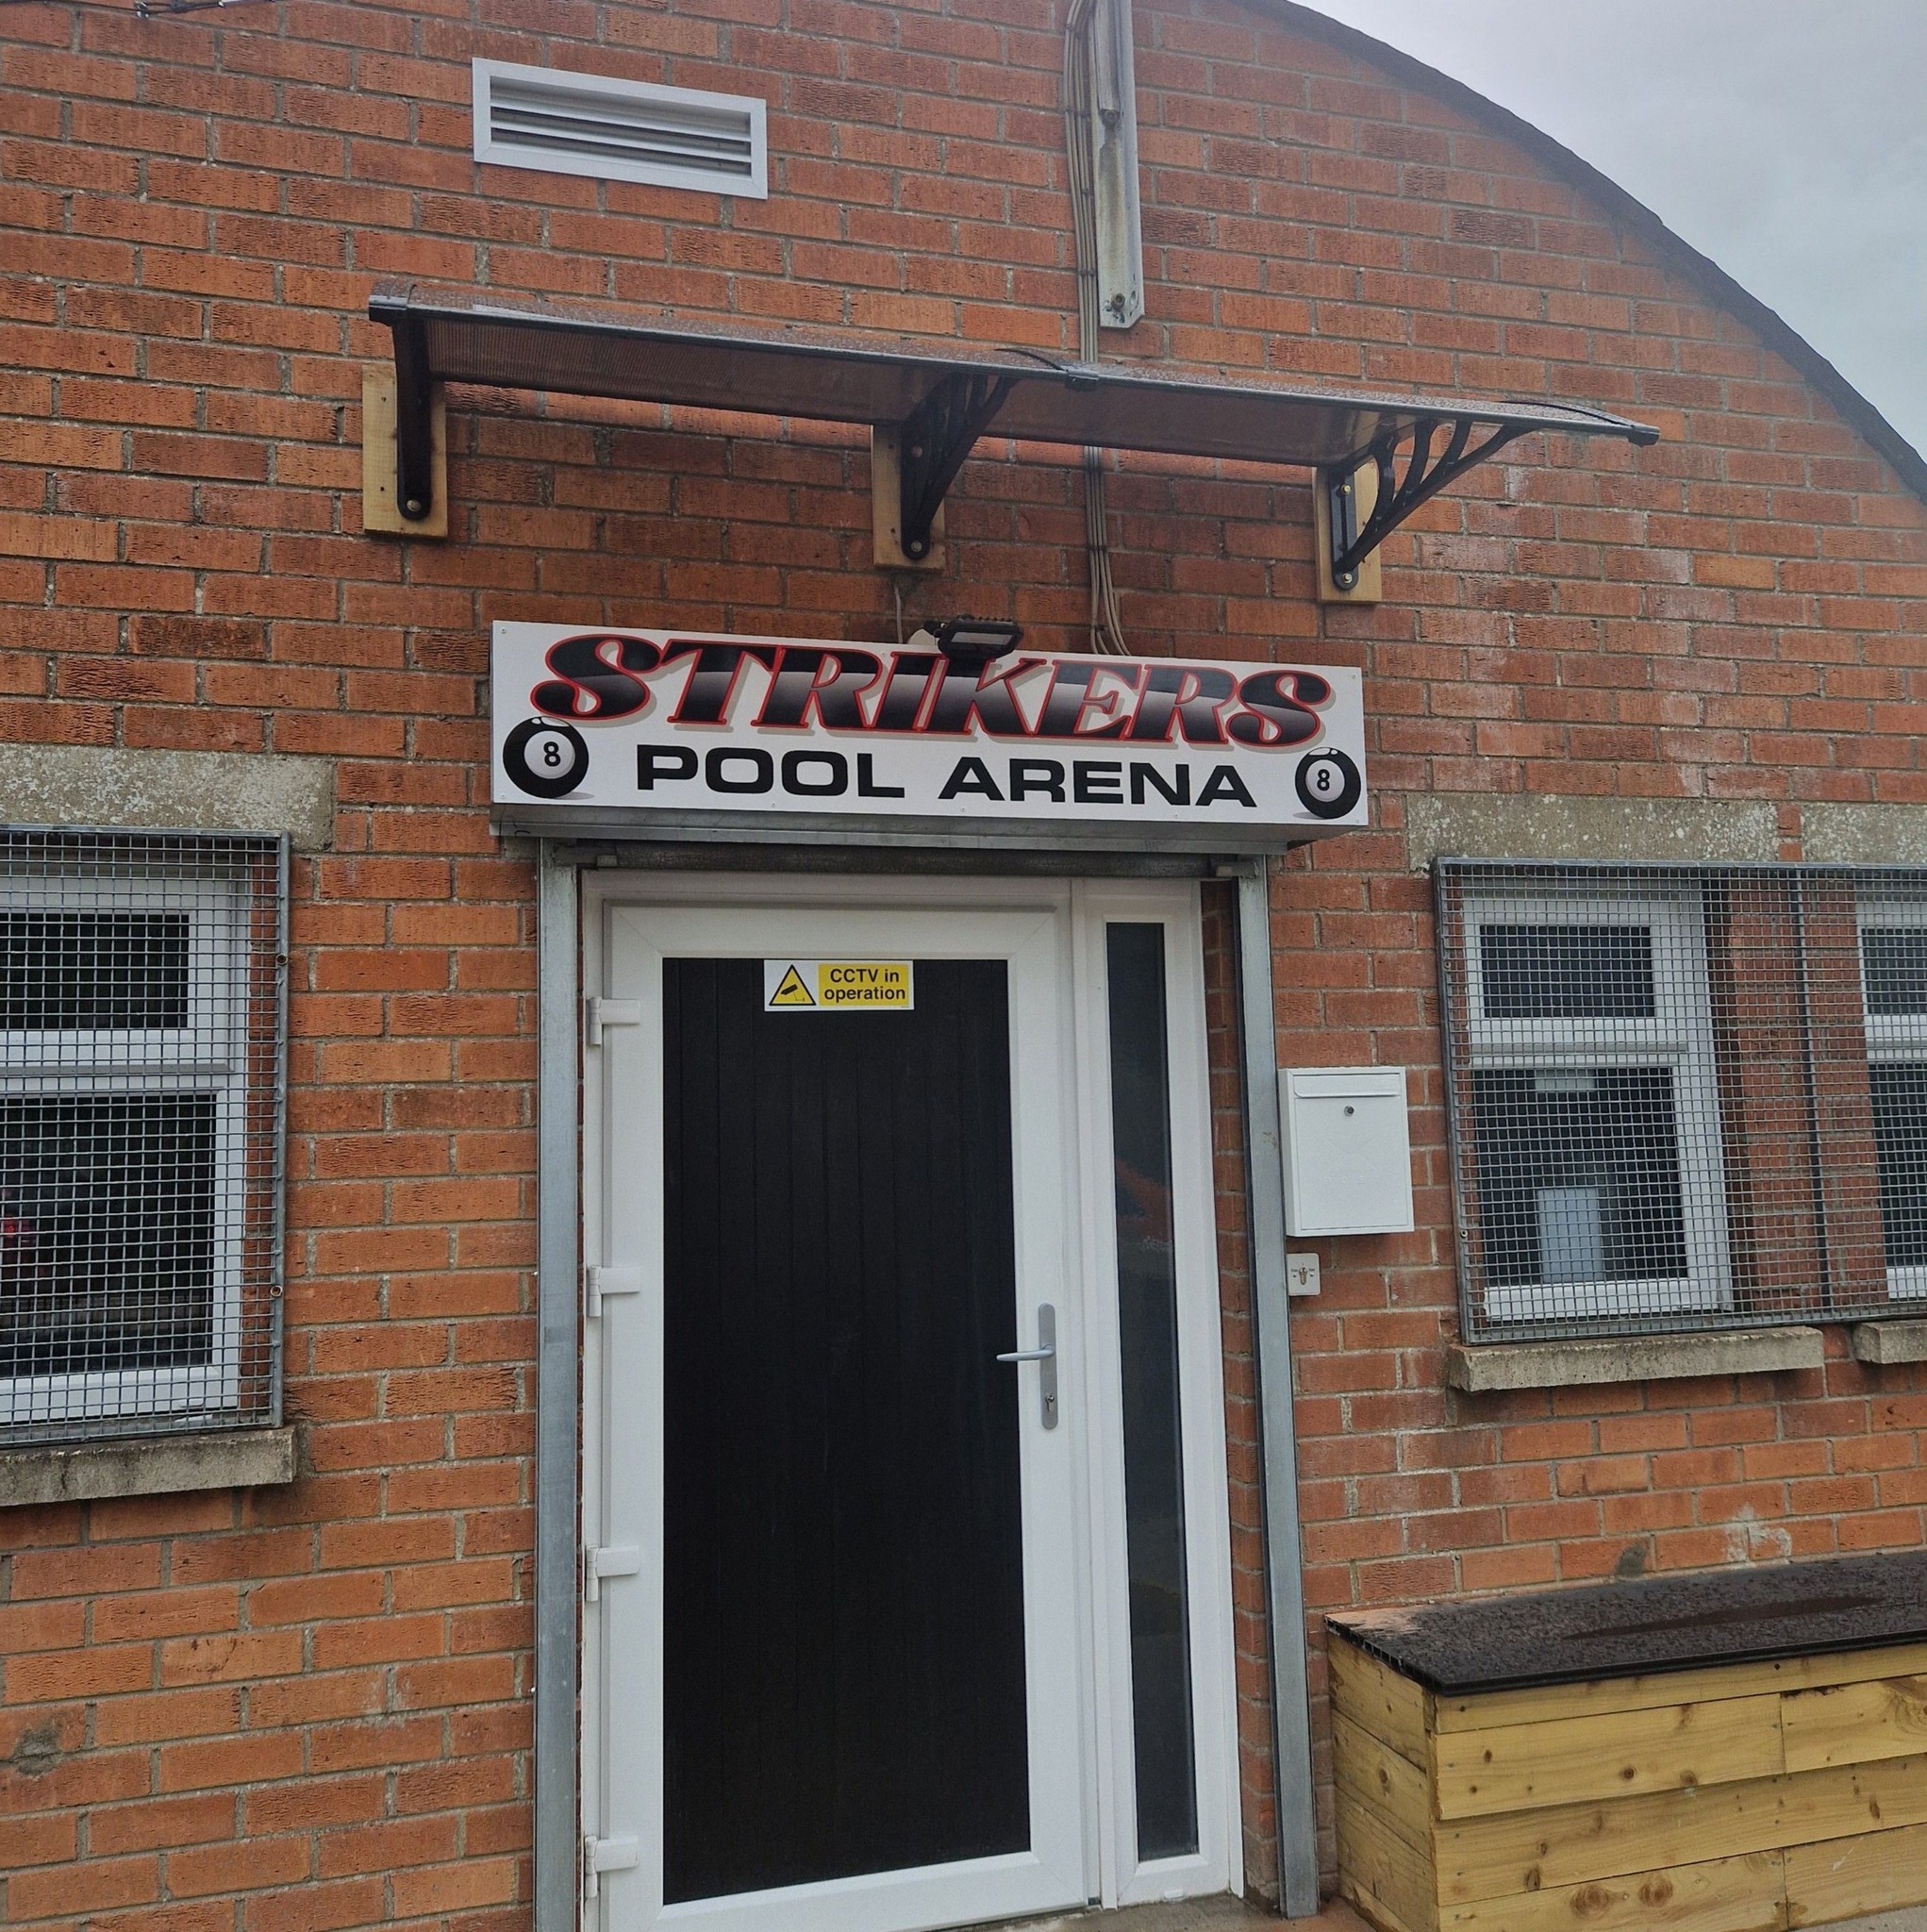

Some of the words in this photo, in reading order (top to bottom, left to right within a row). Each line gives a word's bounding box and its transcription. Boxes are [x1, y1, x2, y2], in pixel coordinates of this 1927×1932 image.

[530, 634, 1331, 748] STRIKERS
[543, 741, 560, 767] 8
[637, 743, 905, 798] POOL
[938, 757, 1256, 807] ARENA
[1316, 768, 1330, 791] 8
[830, 969, 878, 983] CCTV
[885, 969, 899, 983] in
[824, 986, 905, 1003] operation
